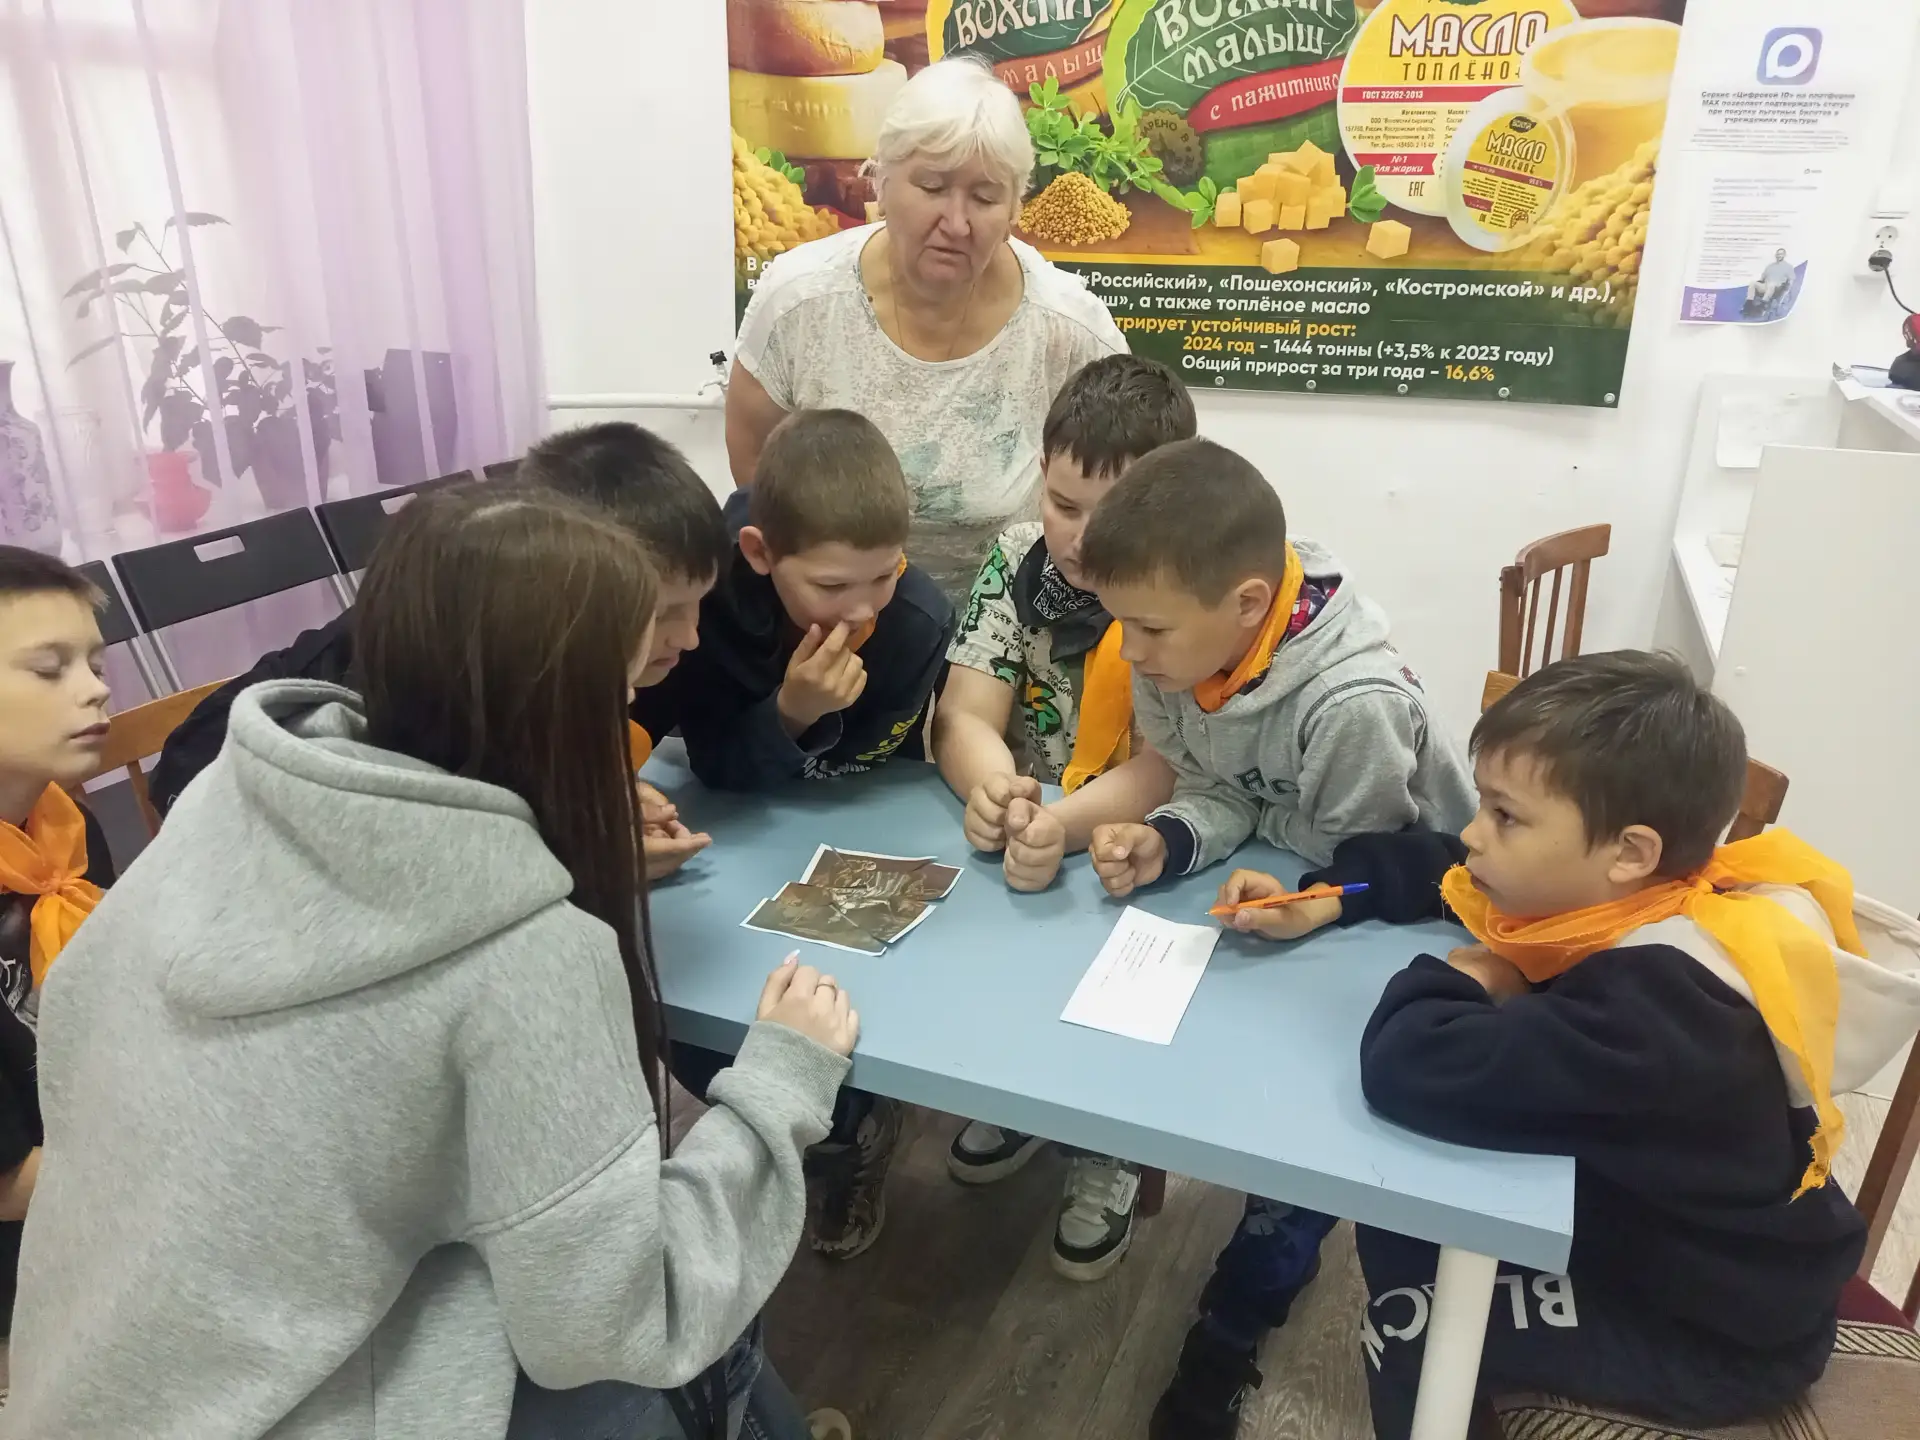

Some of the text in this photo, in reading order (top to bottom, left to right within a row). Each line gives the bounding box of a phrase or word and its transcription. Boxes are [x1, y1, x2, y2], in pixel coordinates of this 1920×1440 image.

[1389, 11, 1549, 58] МАСЛО
[1402, 60, 1521, 81] ТОПЛЁНО
[1362, 90, 1423, 99] ГОСТ 32262-2013
[1486, 129, 1548, 164] МАСЛО
[1391, 166, 1424, 174] жарки
[1551, 285, 1564, 299] и
[1568, 280, 1617, 304] др.),
[1139, 297, 1151, 308] а
[1156, 297, 1212, 311] также
[1217, 297, 1306, 313] топлёное
[1311, 300, 1371, 315] масло
[1190, 317, 1302, 336] устойчивый
[1306, 322, 1357, 339] рост:
[1183, 336, 1223, 352] 2024
[1227, 341, 1255, 355] год
[1273, 339, 1313, 355] 1444
[1317, 344, 1373, 358] тонны
[1377, 340, 1435, 361] (+3,5%
[1440, 349, 1451, 360] к
[1455, 344, 1501, 362] 2023
[1504, 346, 1555, 367] году)
[1182, 355, 1241, 373] Общий
[1245, 361, 1317, 377] прирост
[1321, 364, 1342, 376] за
[1346, 366, 1378, 380] три
[1383, 367, 1425, 381] года
[1445, 365, 1496, 383] 16,6%
[1360, 1272, 1579, 1373] BLCK
